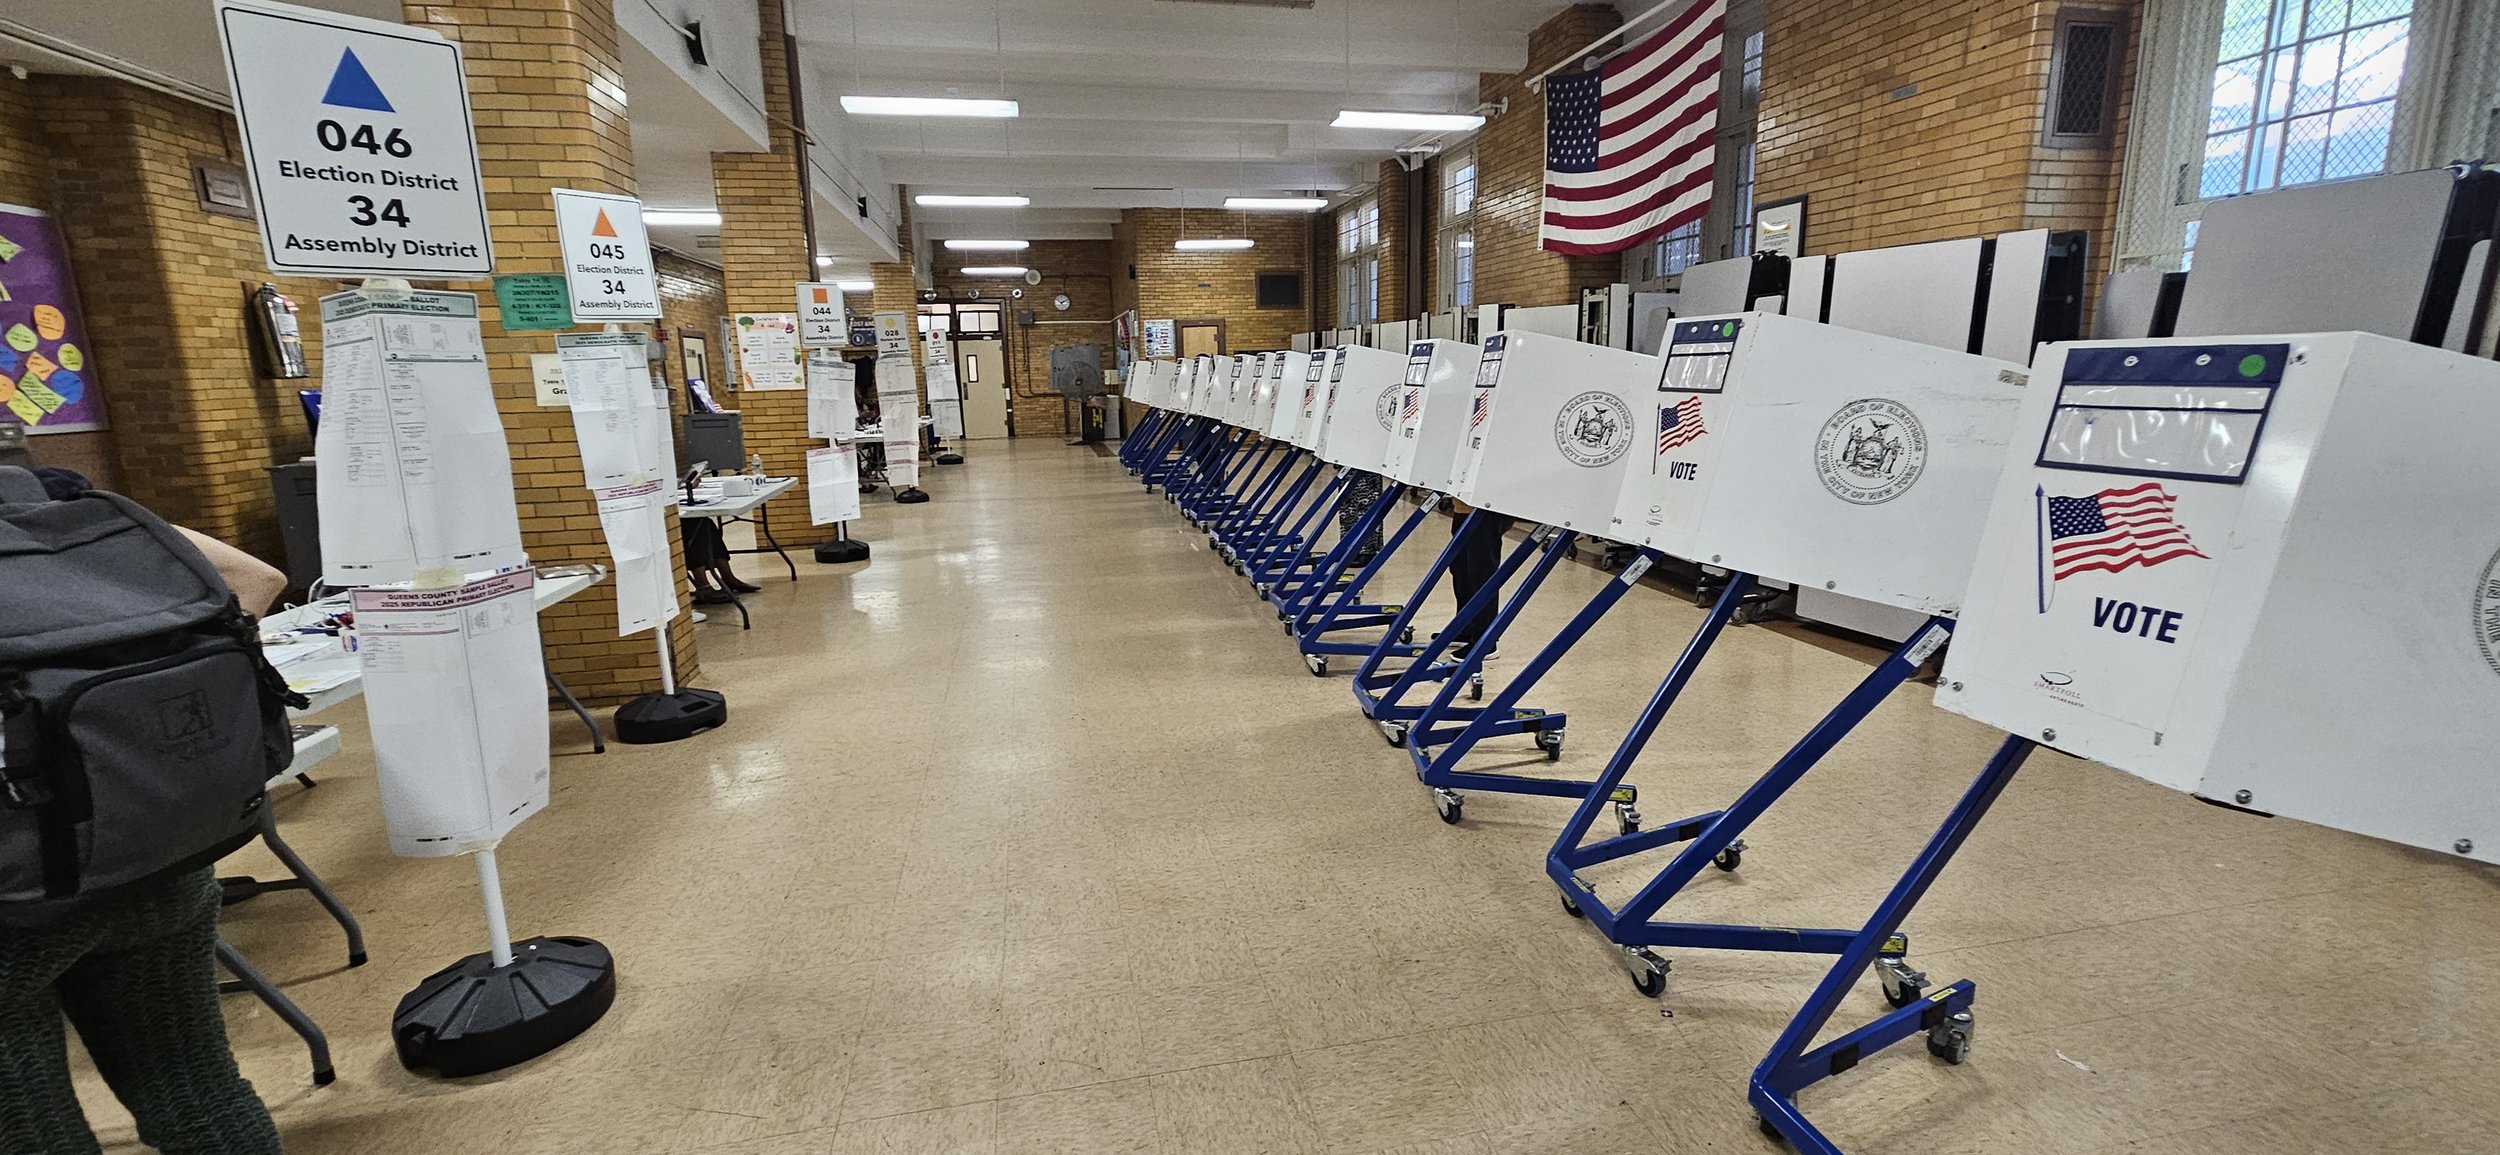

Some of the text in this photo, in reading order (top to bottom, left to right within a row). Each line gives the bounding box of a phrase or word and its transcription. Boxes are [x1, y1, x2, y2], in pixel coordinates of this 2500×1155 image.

[317, 119, 413, 158] 046
[279, 160, 459, 191] Election District
[347, 195, 411, 228] 34
[285, 233, 479, 259] Assembly District
[590, 242, 625, 260] 045
[577, 264, 644, 276] Election District
[602, 279, 626, 295] 34
[410, 296, 440, 304] BALLOT
[411, 304, 450, 312] ELECTION
[579, 300, 655, 311] Assembly District
[812, 307, 832, 316] 044
[817, 325, 831, 334] 34
[1565, 395, 1591, 413] BOARD
[1830, 403, 1923, 453] BOARD OF ELECTIONS
[1592, 455, 1610, 464] NEW
[1669, 461, 1698, 481] VOTE
[1850, 490, 1866, 500] OF
[1868, 486, 1894, 500] NEW
[1893, 464, 1920, 489] YORK
[401, 599, 454, 607] REPUBLICAN
[456, 591, 486, 603] PRIMARY
[487, 584, 515, 595] ELECTION
[421, 591, 458, 599] COUNTY
[460, 584, 486, 595] SAMPLE
[2093, 596, 2184, 644] VOTE
